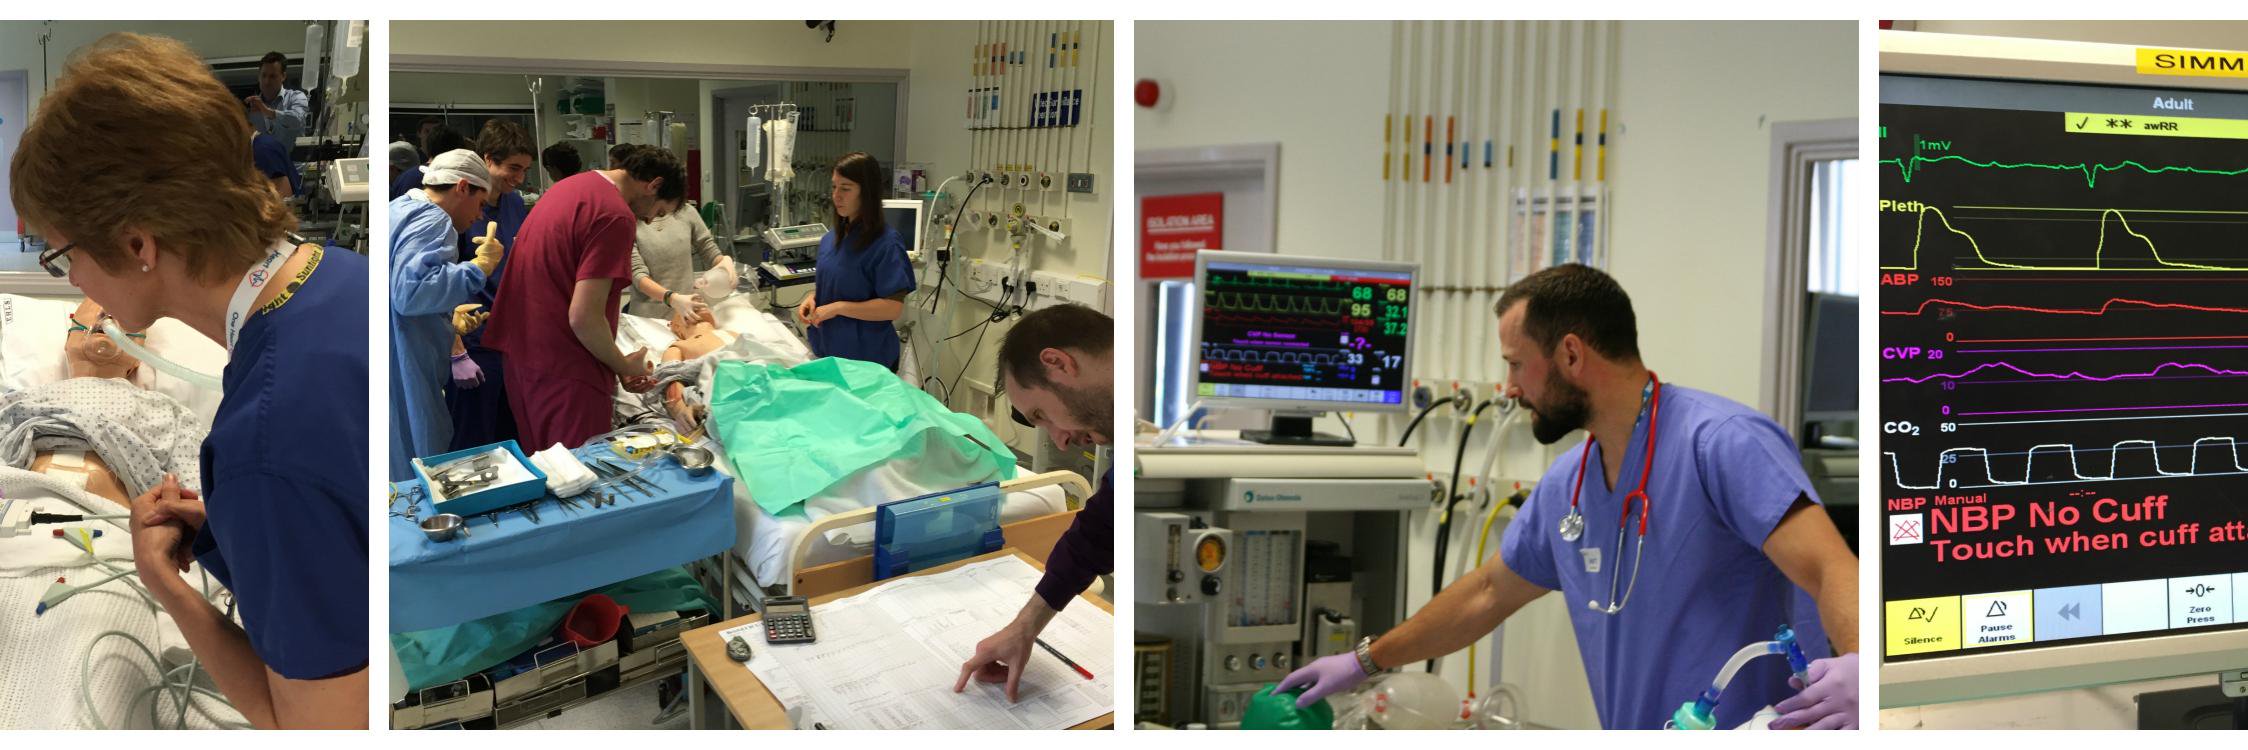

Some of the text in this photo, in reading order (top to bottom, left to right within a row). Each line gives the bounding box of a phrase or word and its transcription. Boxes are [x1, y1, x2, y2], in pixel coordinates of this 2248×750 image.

[2155, 54, 2244, 71] SIMM
[2153, 97, 2194, 110] Adult
[2144, 122, 2178, 131] awRR
[1920, 140, 1952, 150] 1mV
[1880, 200, 1925, 212] Pleth
[1881, 274, 1953, 287] ABP 150
[1352, 286, 1372, 300] 68
[1387, 288, 1407, 302] 68
[1351, 303, 1371, 317] 95
[1385, 305, 1408, 319] 32.1
[1384, 322, 1408, 336] 37.2
[1946, 332, 1954, 342] 0
[1347, 353, 1363, 365] 33
[1882, 347, 1943, 360] CVP 20
[1382, 355, 1402, 369] 17
[1941, 381, 1955, 391] 10
[1942, 405, 1950, 415] 0
[1940, 422, 1956, 432] 50
[1941, 454, 1957, 464] 25
[1949, 479, 1957, 488] 0
[1887, 493, 1987, 511] NBP Manual
[1930, 495, 2168, 535] NBP No Cuff
[1930, 521, 2248, 562] Touch when cuff att
[2189, 606, 2212, 614] Zero
[2187, 616, 2215, 624] Press
[1980, 623, 2013, 633] Pause
[1904, 636, 1943, 646] Silence
[1978, 634, 2016, 644] Alarms
